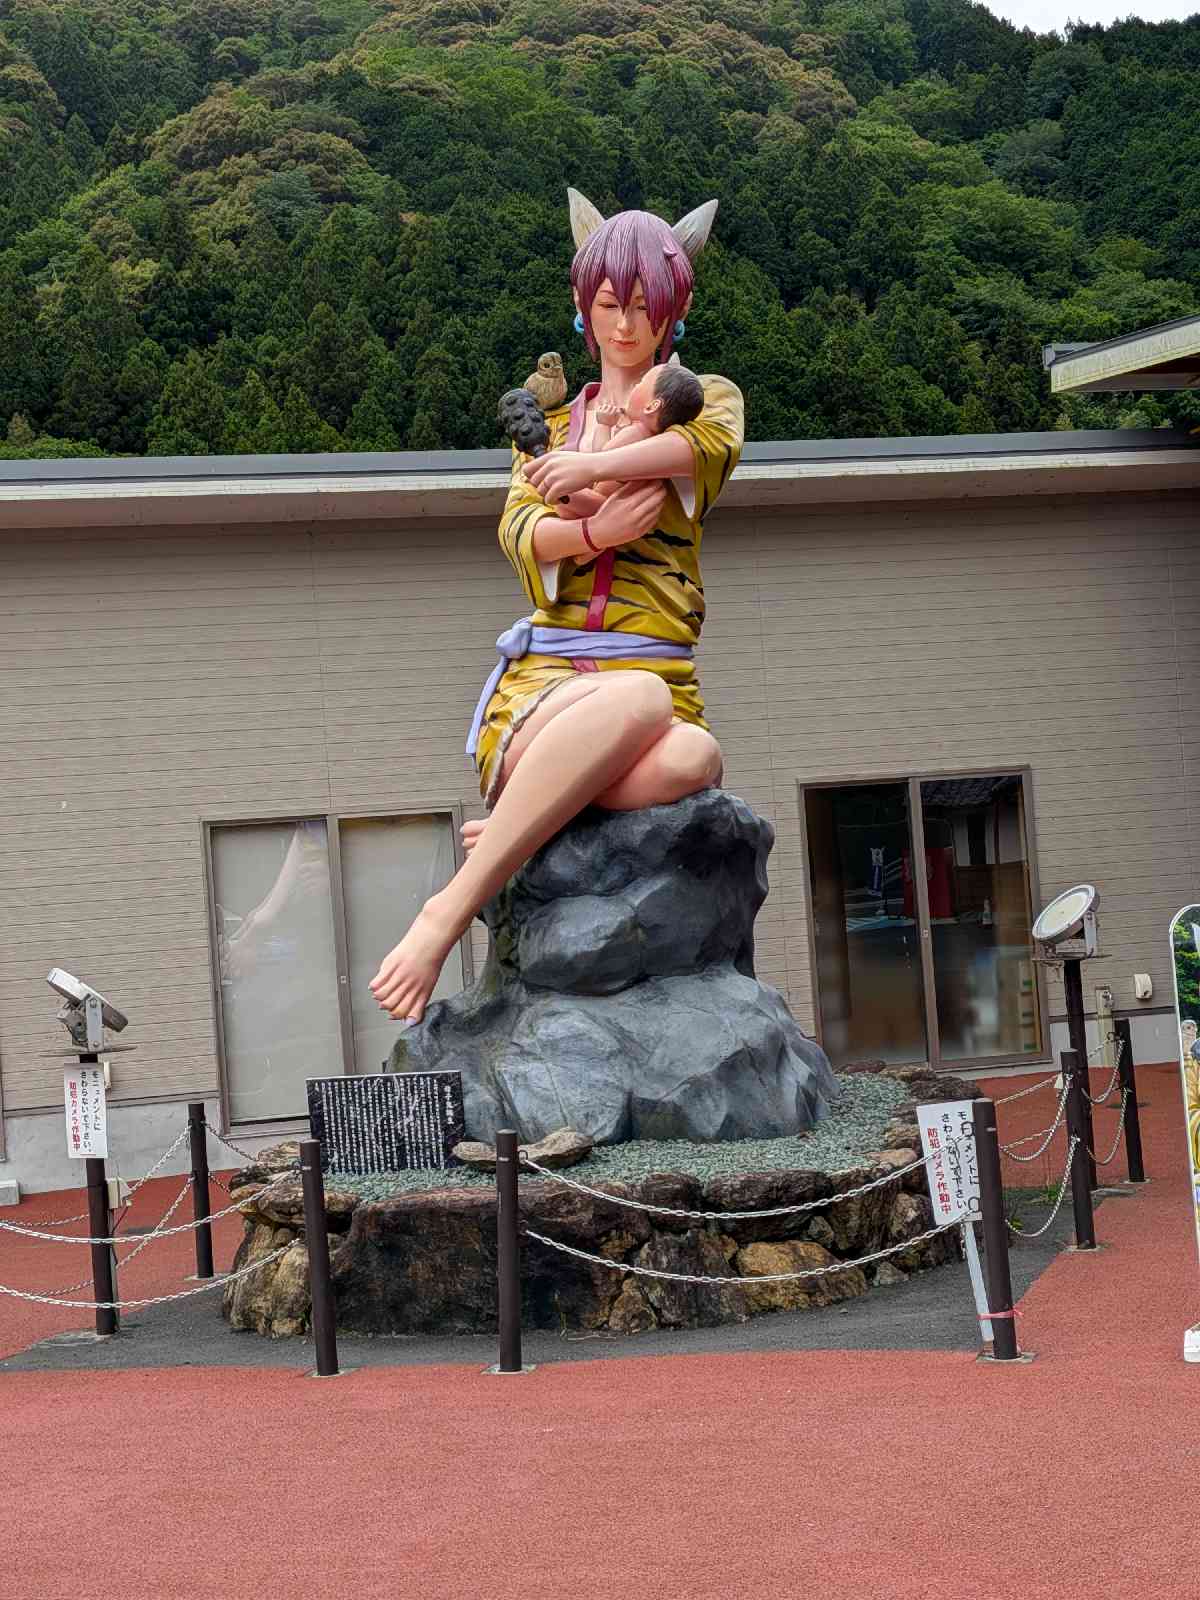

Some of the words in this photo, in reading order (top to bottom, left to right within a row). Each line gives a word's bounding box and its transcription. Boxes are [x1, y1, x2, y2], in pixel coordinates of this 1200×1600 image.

[69, 1081, 80, 1152] 防犯カメラ作動中
